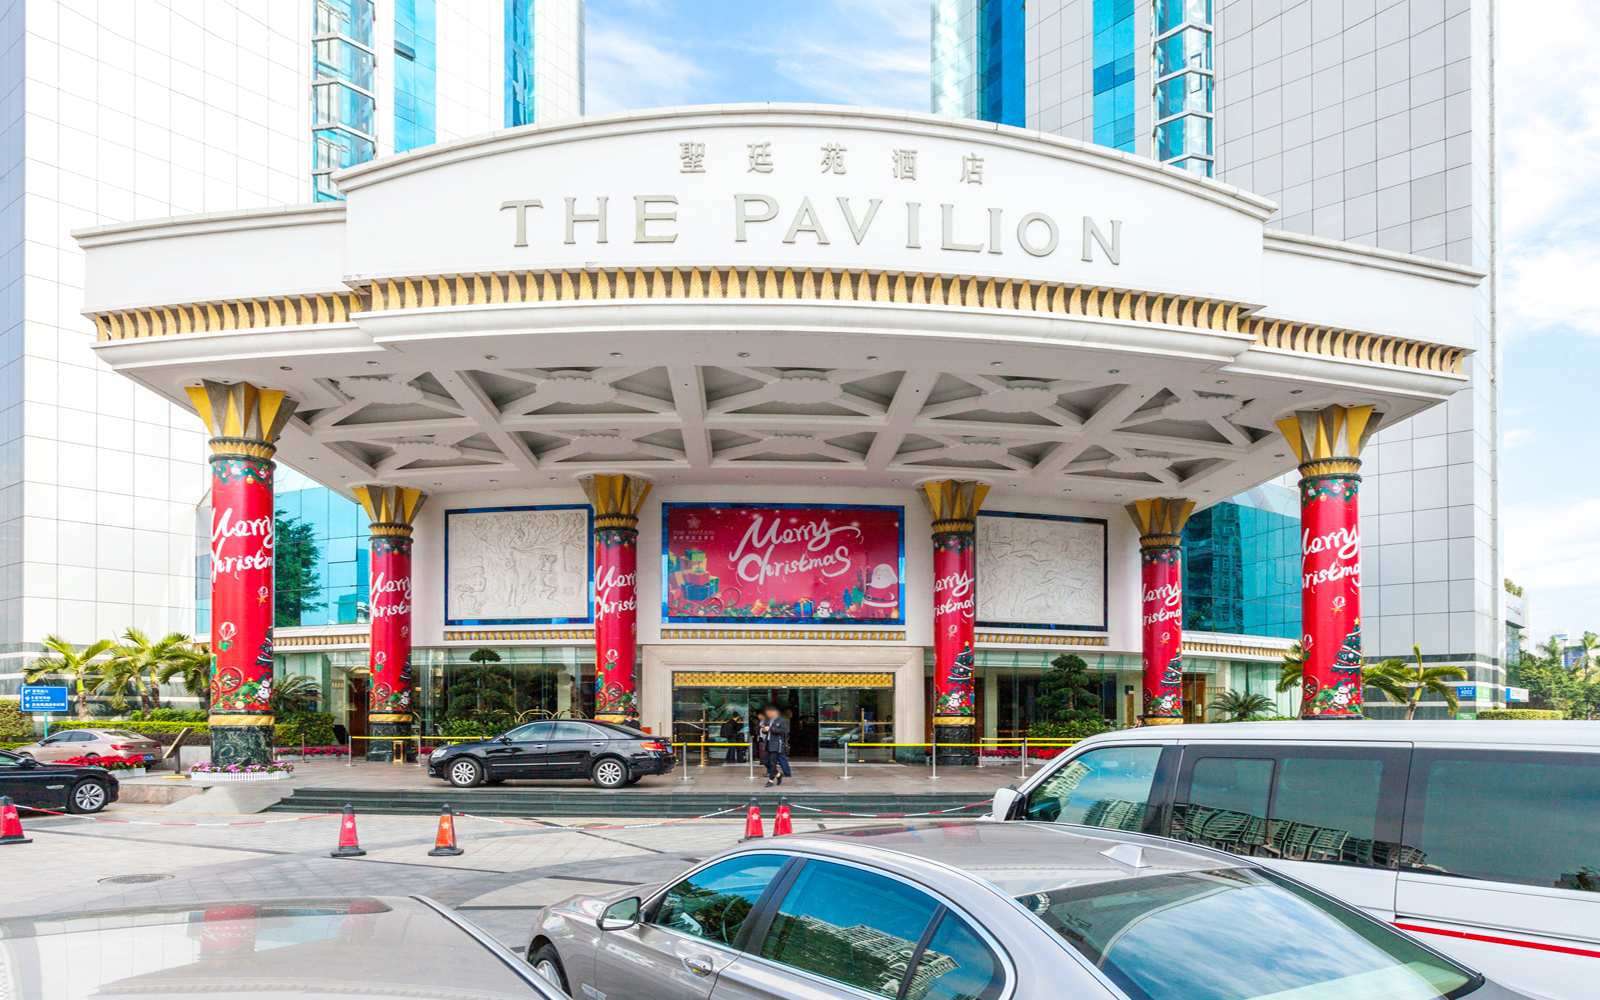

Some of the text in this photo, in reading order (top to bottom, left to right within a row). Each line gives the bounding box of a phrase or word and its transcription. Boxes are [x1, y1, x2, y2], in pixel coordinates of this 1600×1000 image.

[679, 141, 985, 185] 聖廷苑酒店
[500, 192, 1123, 266] THE PAVILION
[211, 536, 274, 584] hristm
[729, 516, 861, 562] Merry
[737, 544, 851, 586] Christmas
[934, 570, 975, 597] erry
